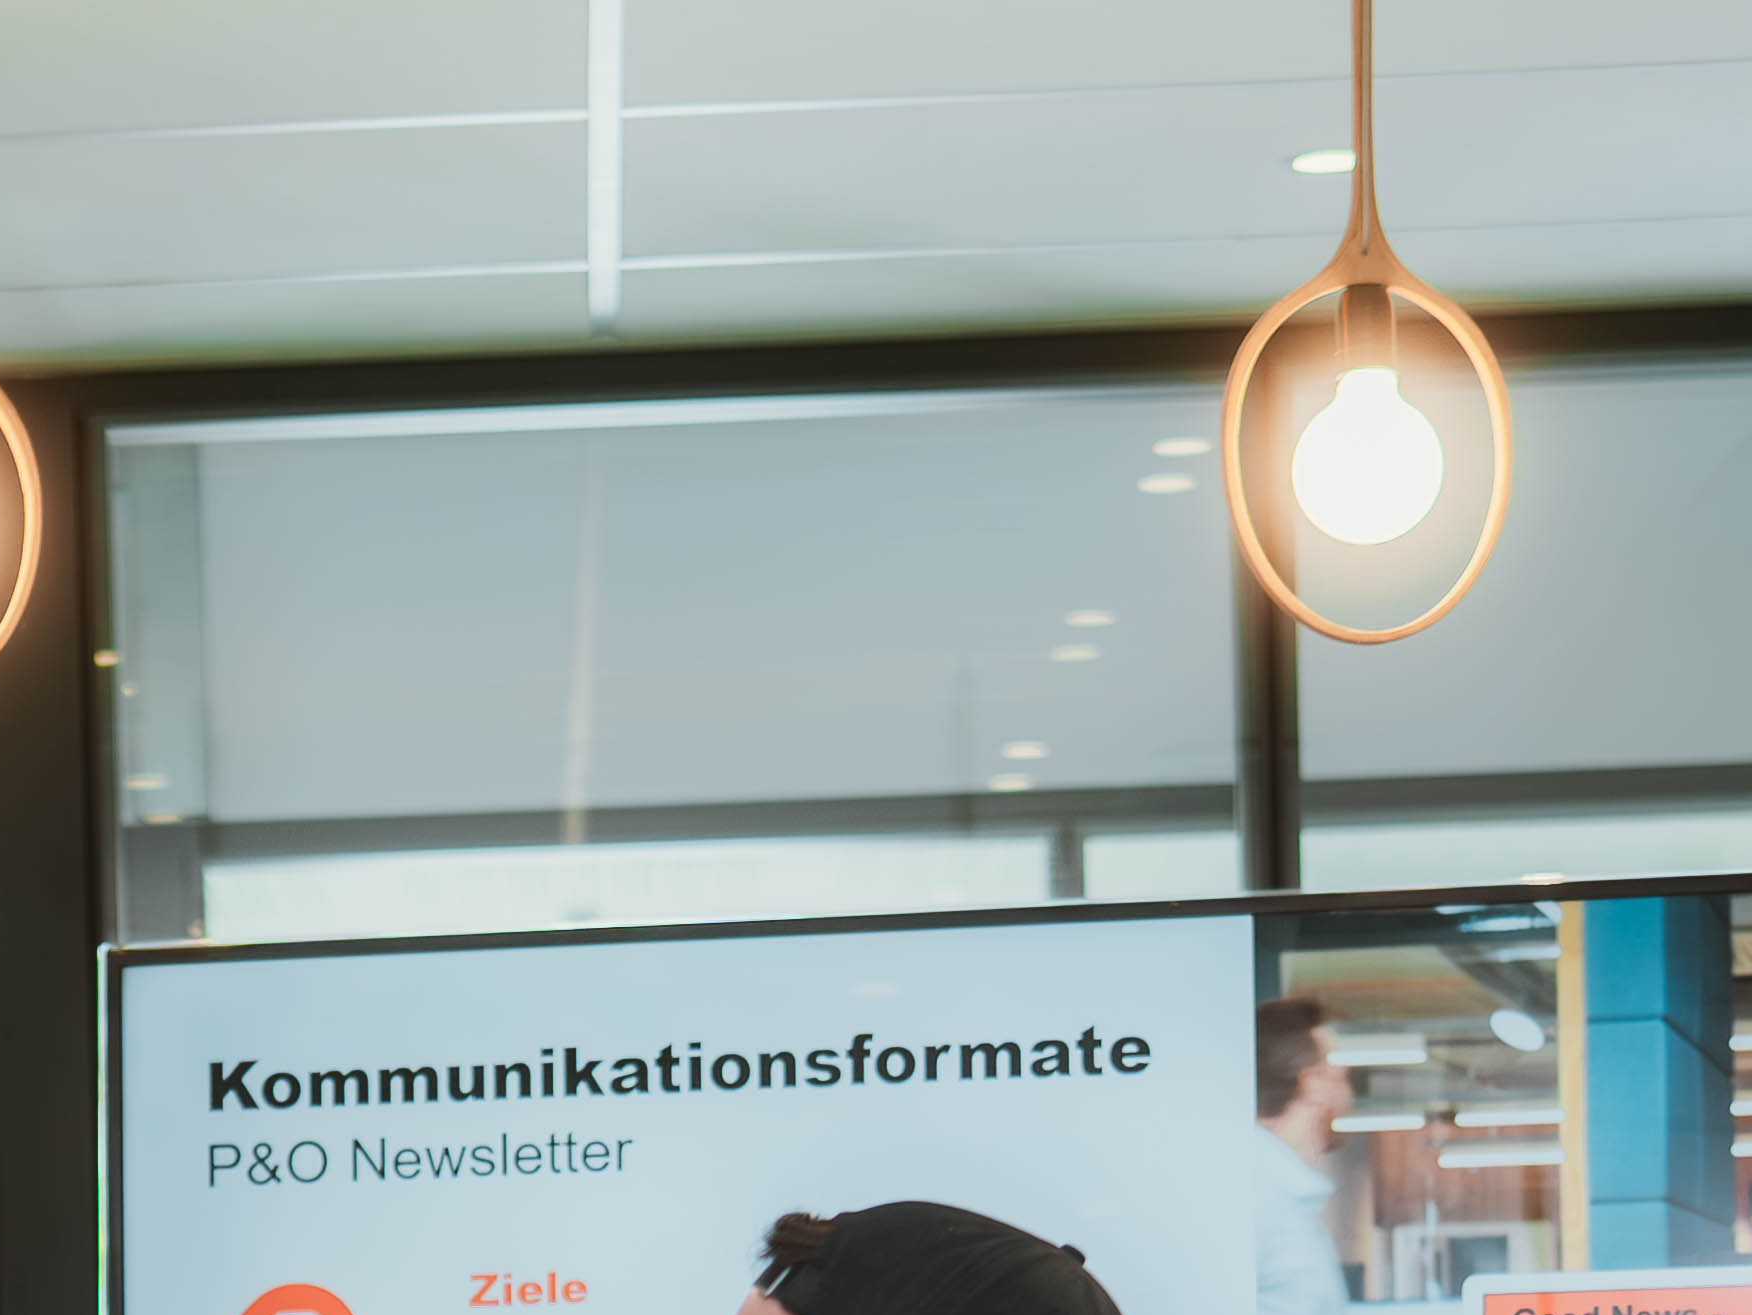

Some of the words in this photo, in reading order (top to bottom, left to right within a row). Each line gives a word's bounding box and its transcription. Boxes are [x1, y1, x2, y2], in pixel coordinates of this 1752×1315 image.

[208, 1025, 1153, 1111] Kommunikationsformate
[208, 1140, 328, 1188] P&O
[351, 1131, 634, 1182] Newsletter
[469, 1271, 588, 1307] Ziele
